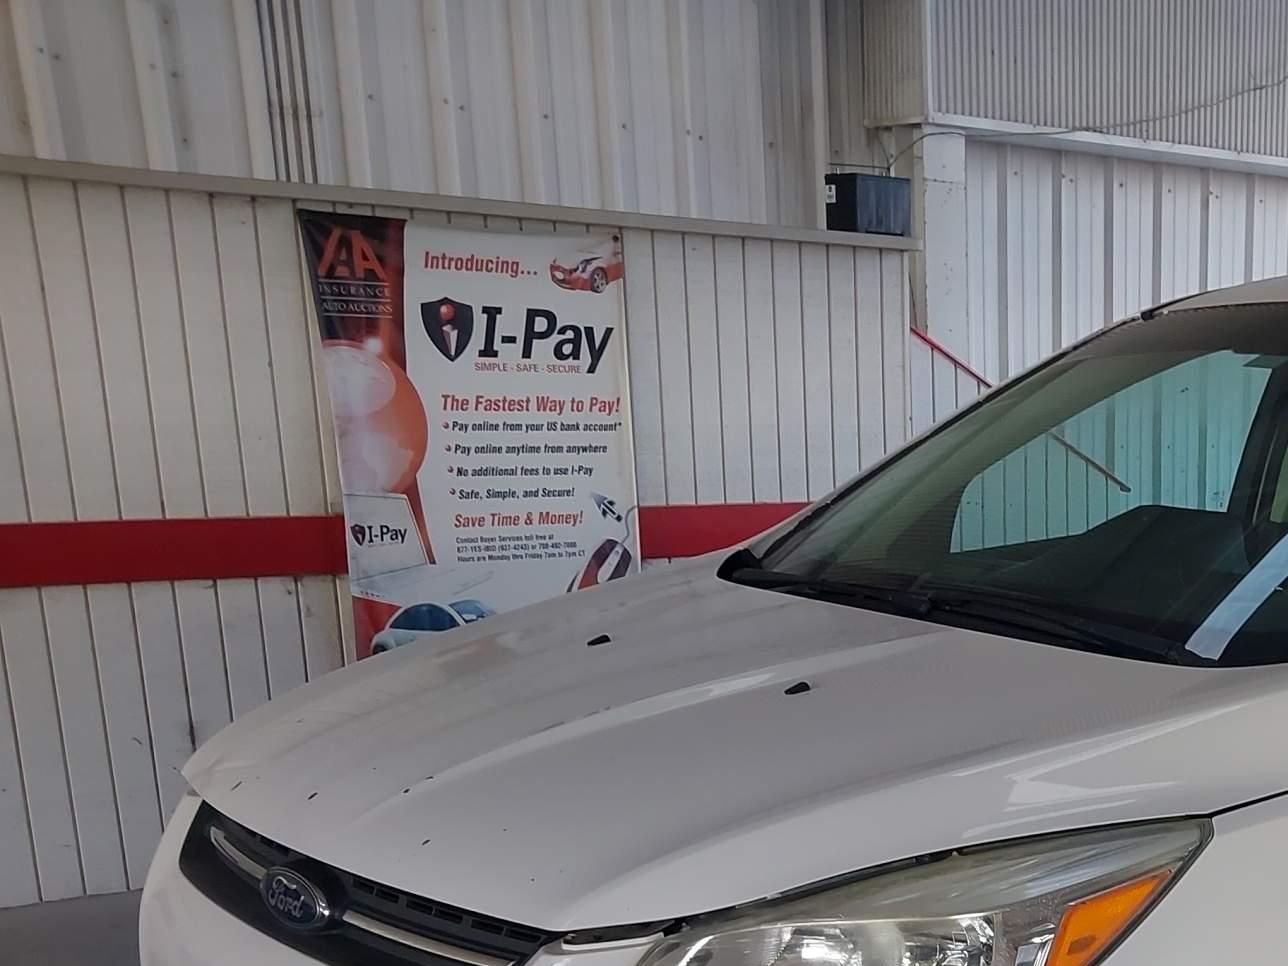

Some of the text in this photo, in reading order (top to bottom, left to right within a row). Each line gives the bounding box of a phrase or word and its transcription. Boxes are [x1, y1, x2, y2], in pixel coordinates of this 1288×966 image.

[424, 251, 538, 278] Introducing...
[319, 284, 391, 297] INSURANCE
[322, 301, 393, 313] AUTO AUCTIONS
[478, 306, 614, 374] I-Pay
[475, 362, 508, 372] SIMPLE
[516, 364, 539, 373] SAFE
[546, 364, 582, 374] SECURE
[441, 394, 621, 416] The Fastest Way to Pay!
[452, 421, 469, 433] Pay
[471, 421, 499, 431] online
[502, 421, 523, 431] from
[525, 423, 544, 433] your
[546, 421, 557, 431] US
[560, 421, 580, 431] bank
[454, 443, 607, 456] Pay online anytime from anywhere
[456, 465, 593, 477] No additional fees to use I-Pay
[458, 487, 575, 500] Safe, Simple, and Secure!
[454, 510, 583, 528] Save Time & Money!
[367, 525, 407, 544] I-Pay
[268, 875, 305, 918] Ford
